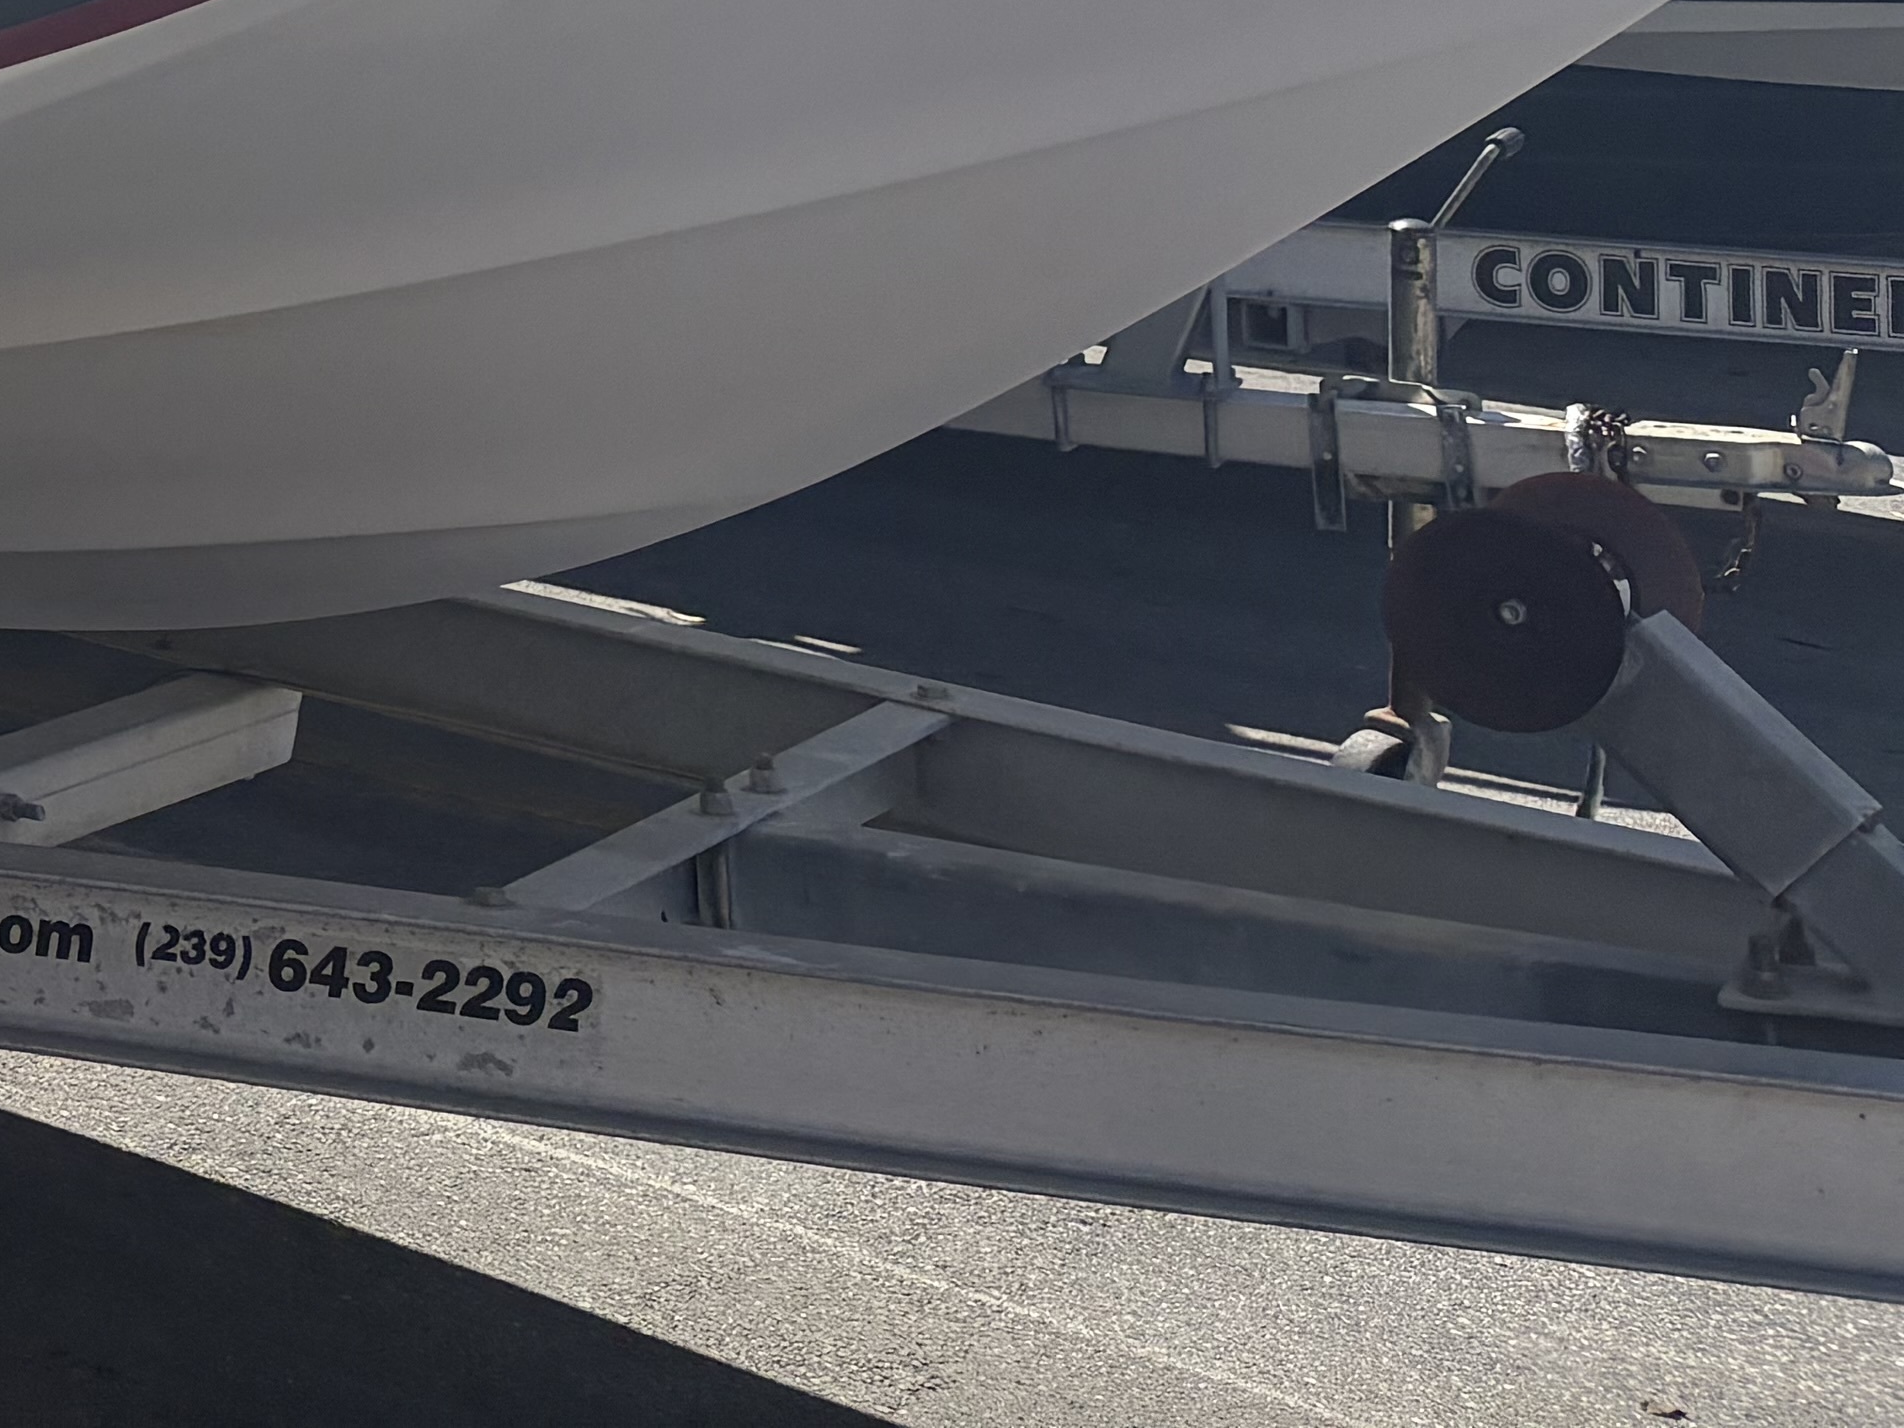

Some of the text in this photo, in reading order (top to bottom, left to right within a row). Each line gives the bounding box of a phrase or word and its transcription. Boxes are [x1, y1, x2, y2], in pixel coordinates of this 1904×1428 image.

[1472, 245, 1904, 338] CONTINE
[135, 922, 253, 981] (239)
[268, 938, 593, 1033] 643-2292
